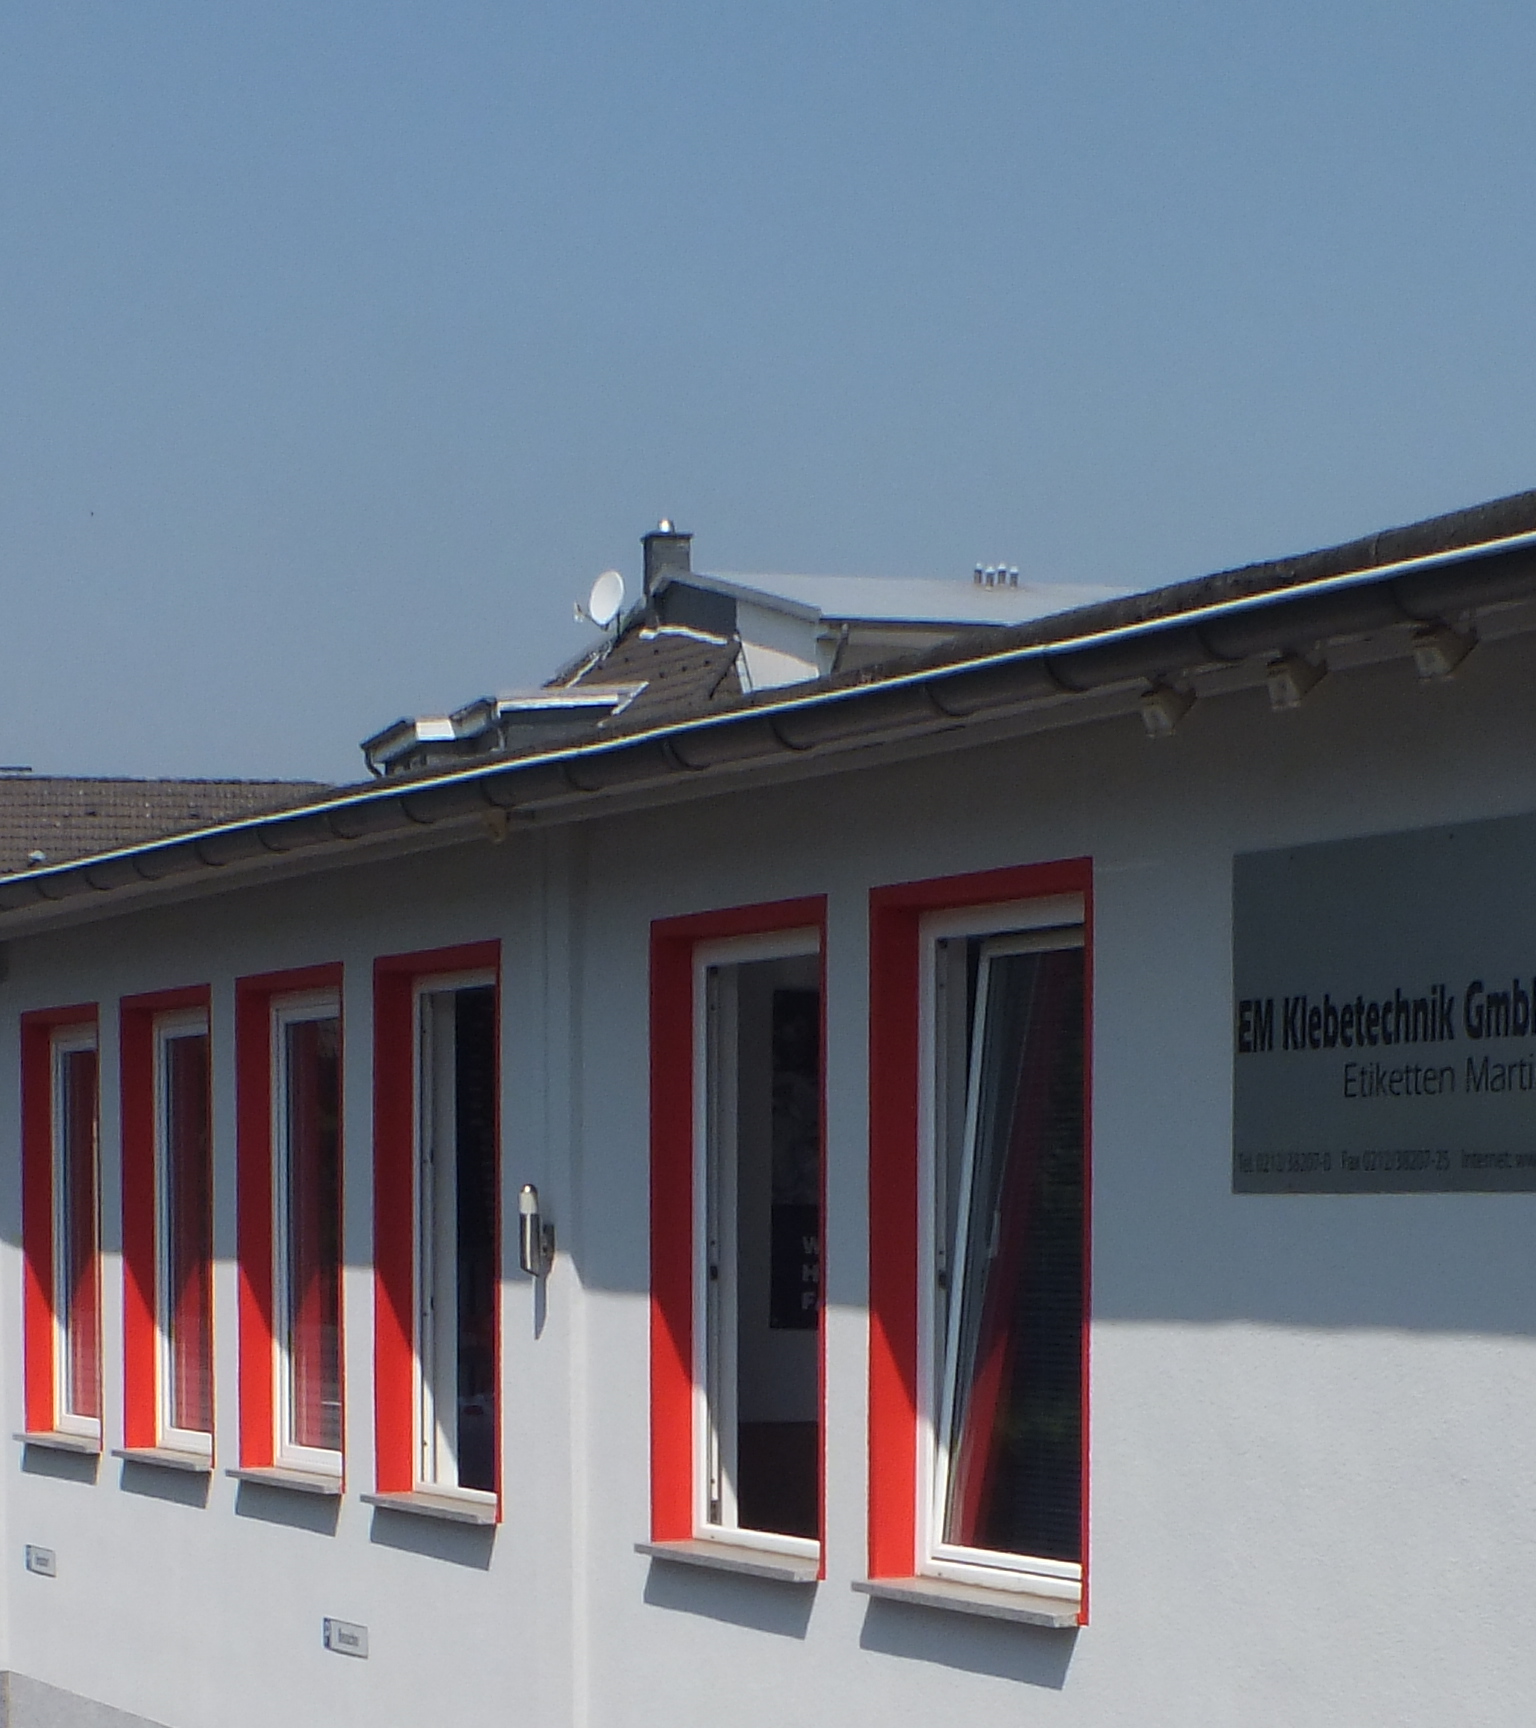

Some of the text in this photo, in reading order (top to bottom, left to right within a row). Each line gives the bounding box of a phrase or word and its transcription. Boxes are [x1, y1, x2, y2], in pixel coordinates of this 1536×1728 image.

[1238, 998, 1275, 1054] EM
[1282, 982, 1455, 1051] Klebetechnik
[1344, 1061, 1456, 1098] Etiketten
